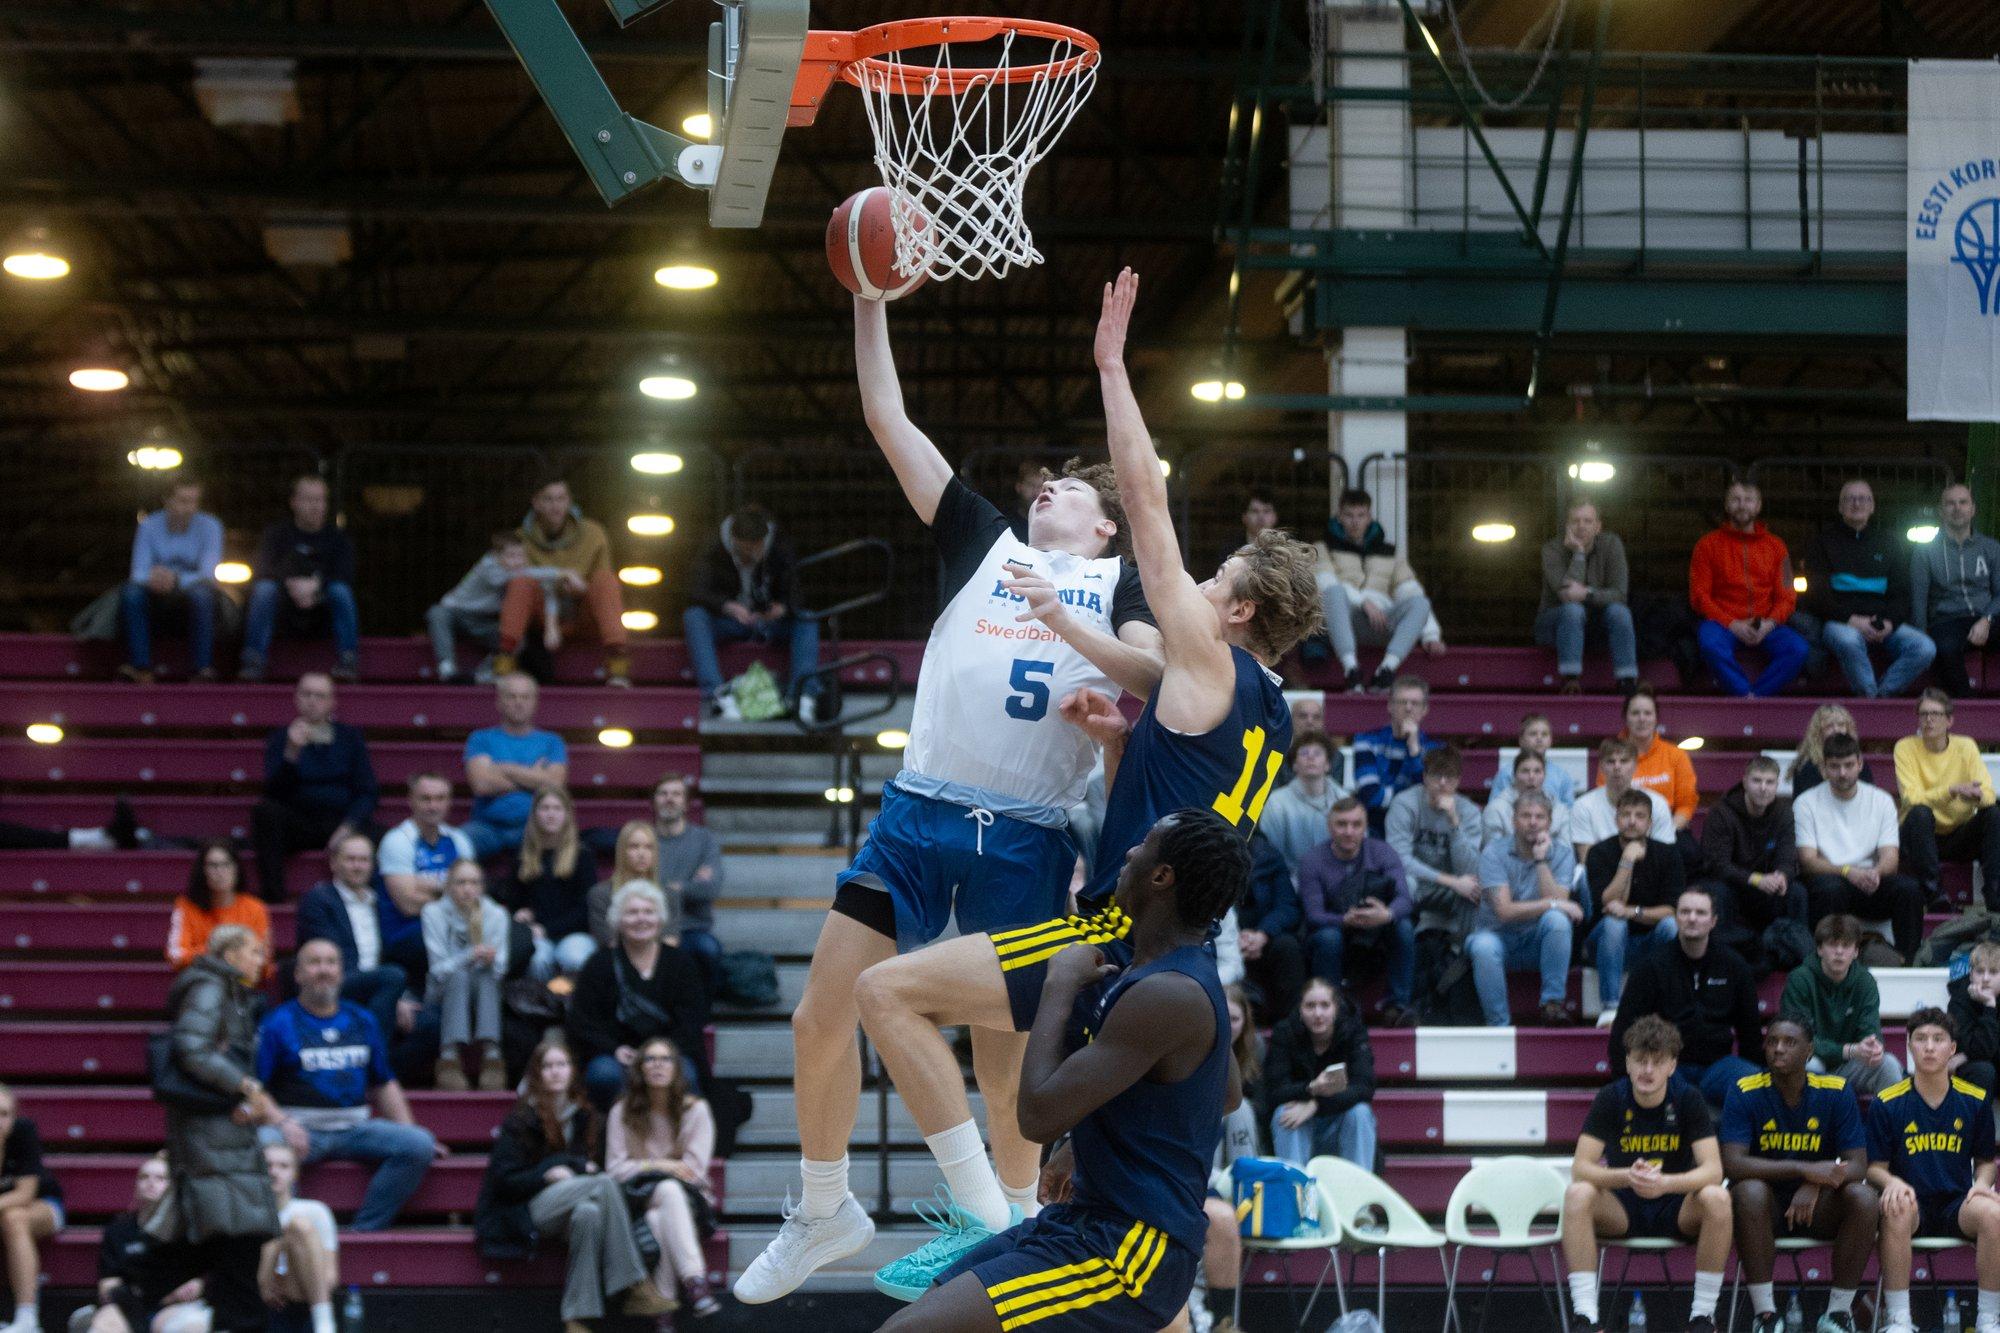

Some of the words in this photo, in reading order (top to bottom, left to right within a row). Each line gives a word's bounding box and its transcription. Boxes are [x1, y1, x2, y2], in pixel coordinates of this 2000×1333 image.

[1916, 181, 1953, 240] EESTI
[1949, 158, 2000, 189] KOR
[974, 618, 1065, 643] Swedban
[1005, 658, 1055, 722] 5
[1211, 725, 1284, 828] 11
[1619, 1134, 1680, 1153] SWEDEN
[1760, 1132, 1821, 1153] SWEDEN
